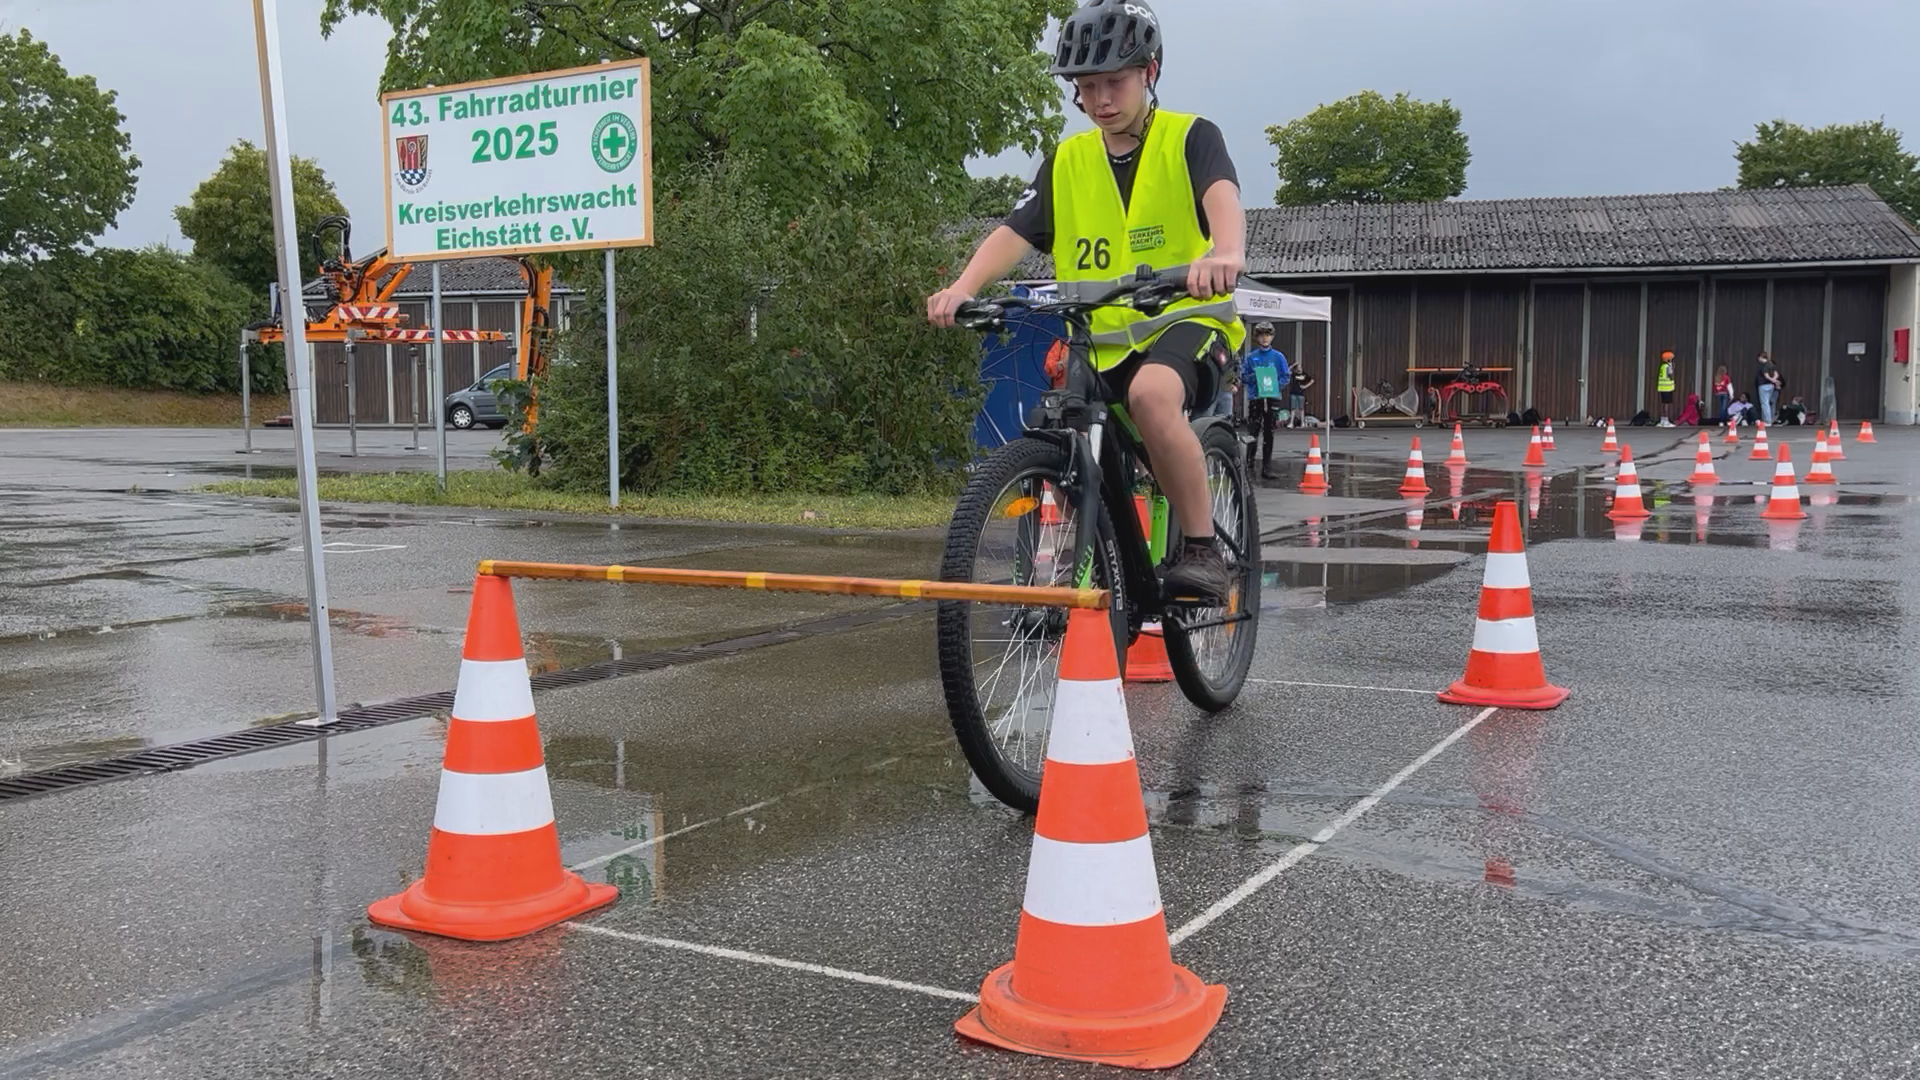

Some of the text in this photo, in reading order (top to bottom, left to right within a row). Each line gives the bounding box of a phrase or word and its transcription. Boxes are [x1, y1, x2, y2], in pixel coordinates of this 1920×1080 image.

[391, 76, 638, 128] 43. Fahrradturnier
[471, 121, 559, 164] 2025
[399, 183, 637, 226] Kreisverkehrswacht
[437, 217, 594, 251] Eichstätt e.V.
[1128, 229, 1164, 240] VERKEHRS
[1076, 237, 1111, 271] 26
